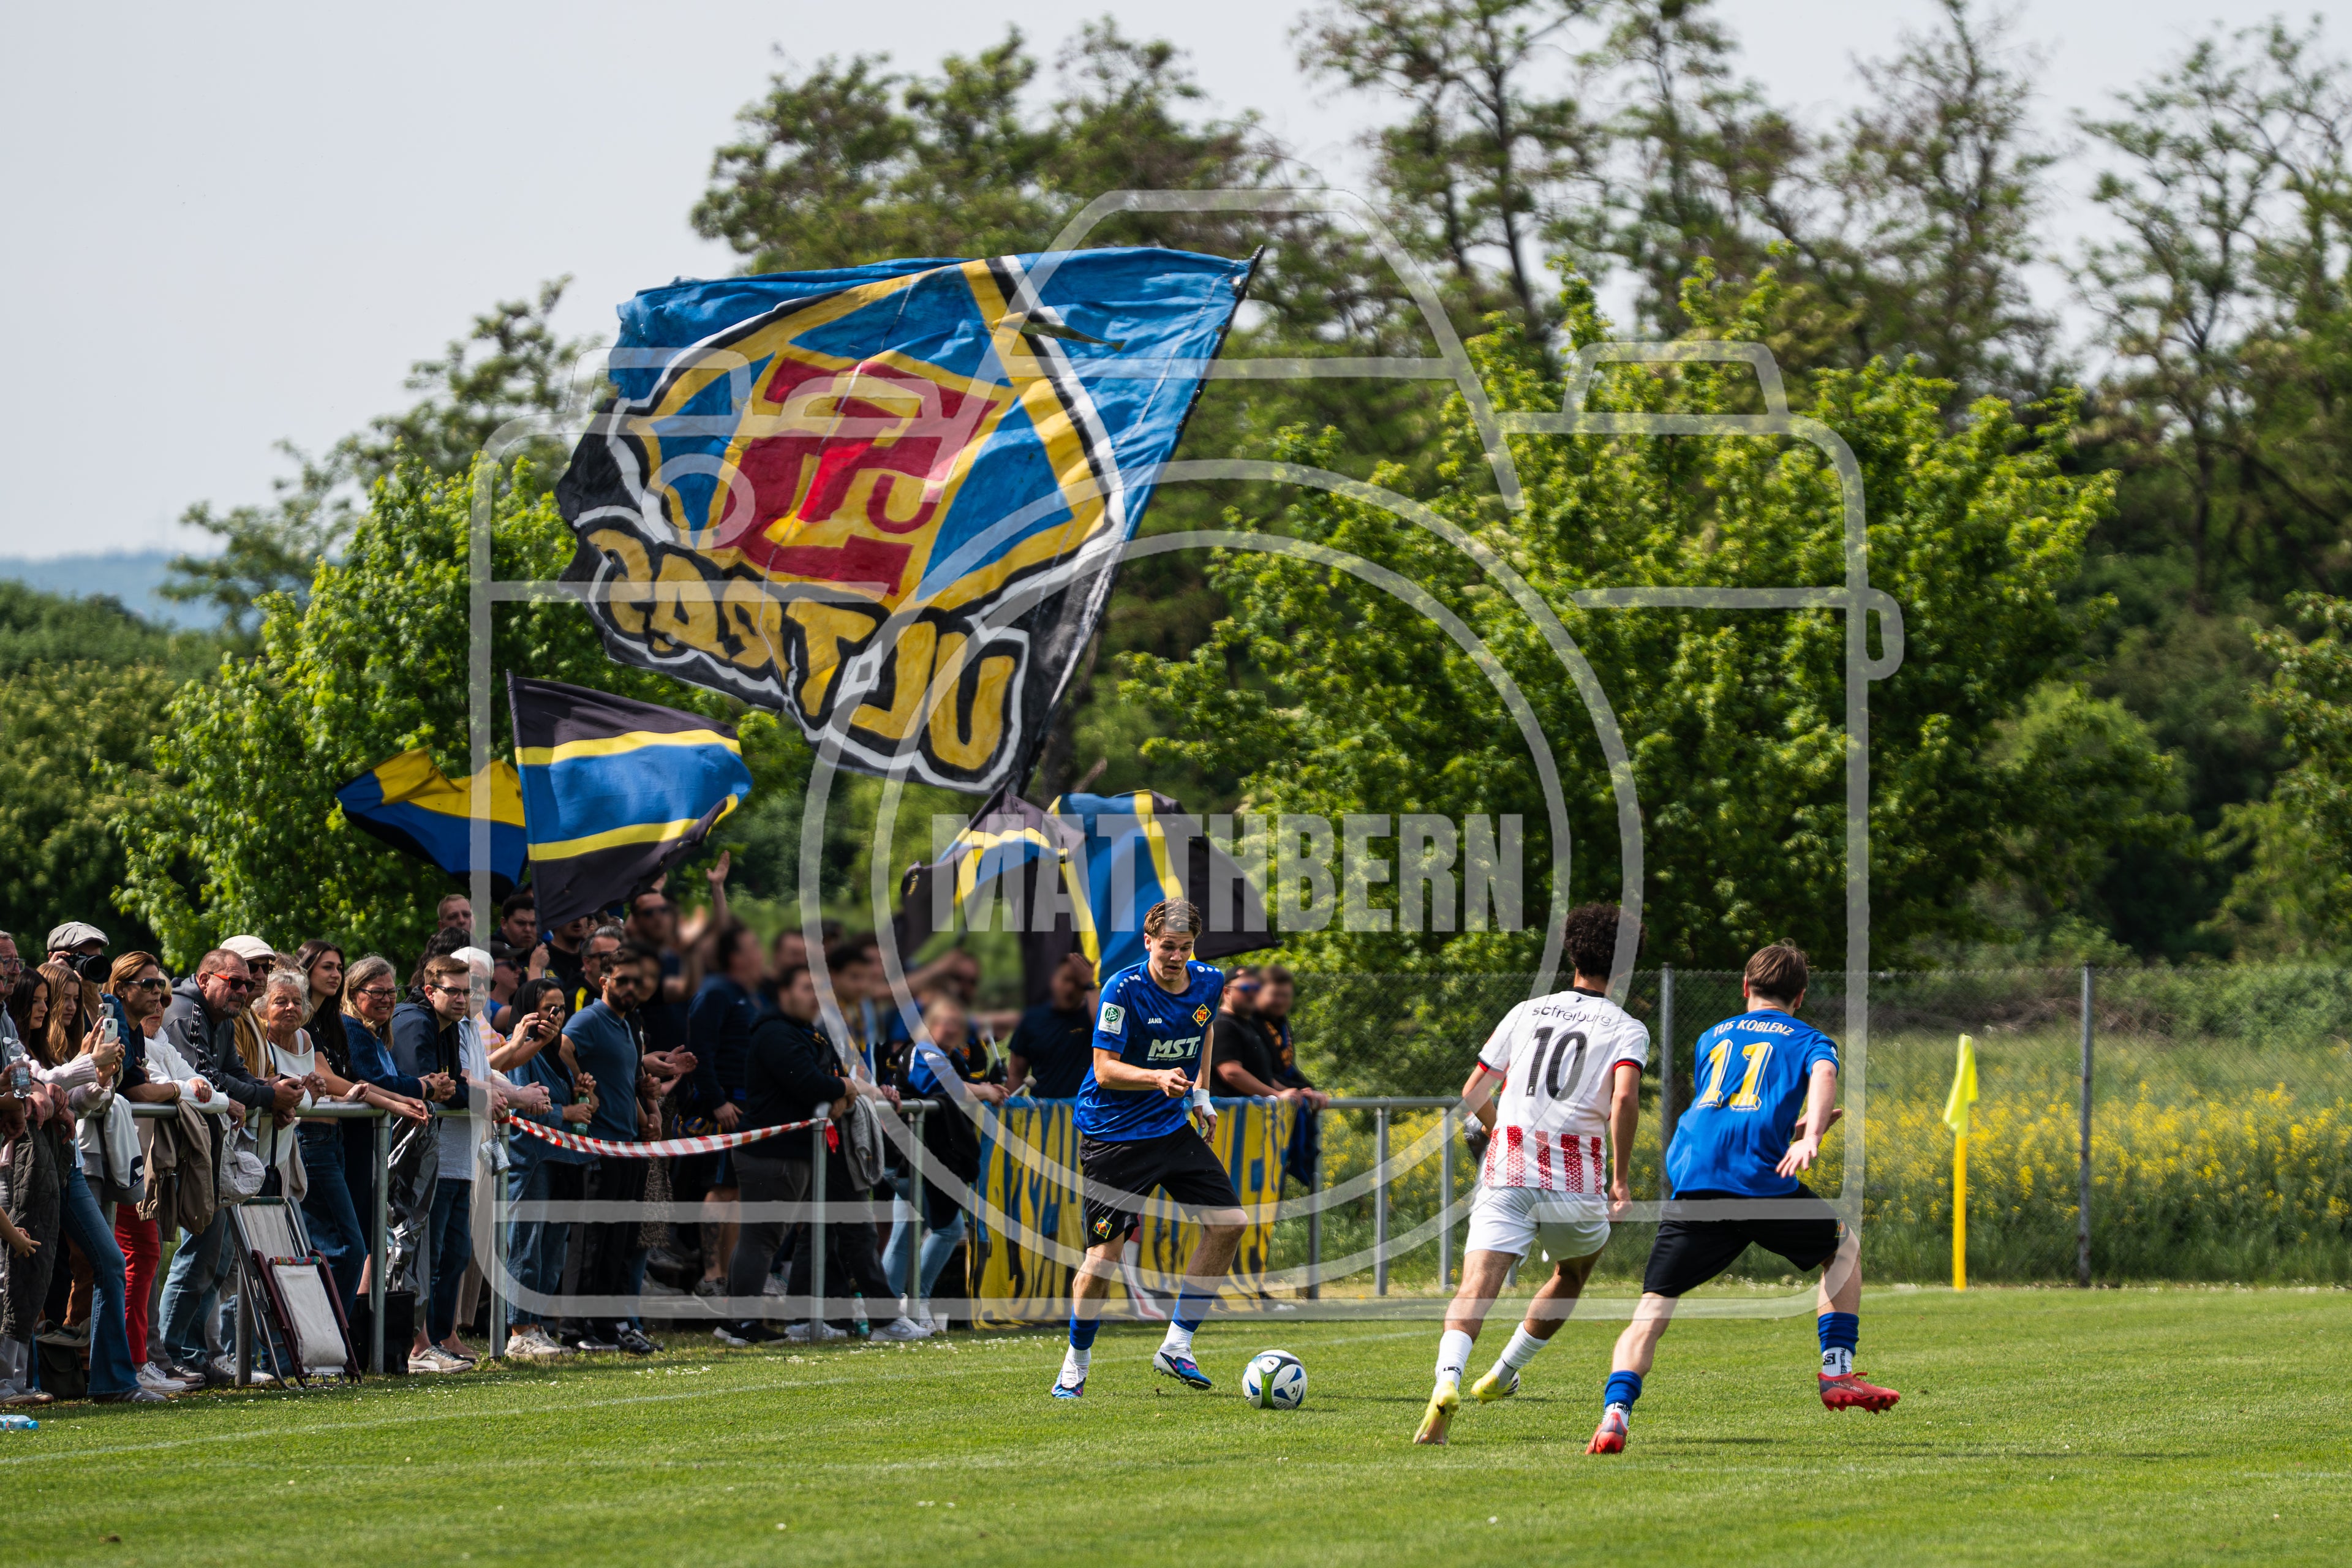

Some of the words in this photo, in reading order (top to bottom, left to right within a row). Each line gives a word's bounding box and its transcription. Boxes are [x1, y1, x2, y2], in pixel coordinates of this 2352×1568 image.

[1532, 1005, 1612, 1027] scfreiburg
[1713, 1020, 1736, 1037] TUS
[1736, 1019, 1795, 1036] KOBLENZ
[1148, 1036, 1200, 1057] MST
[1525, 1025, 1588, 1101] 10
[1697, 1039, 1773, 1111] 11
